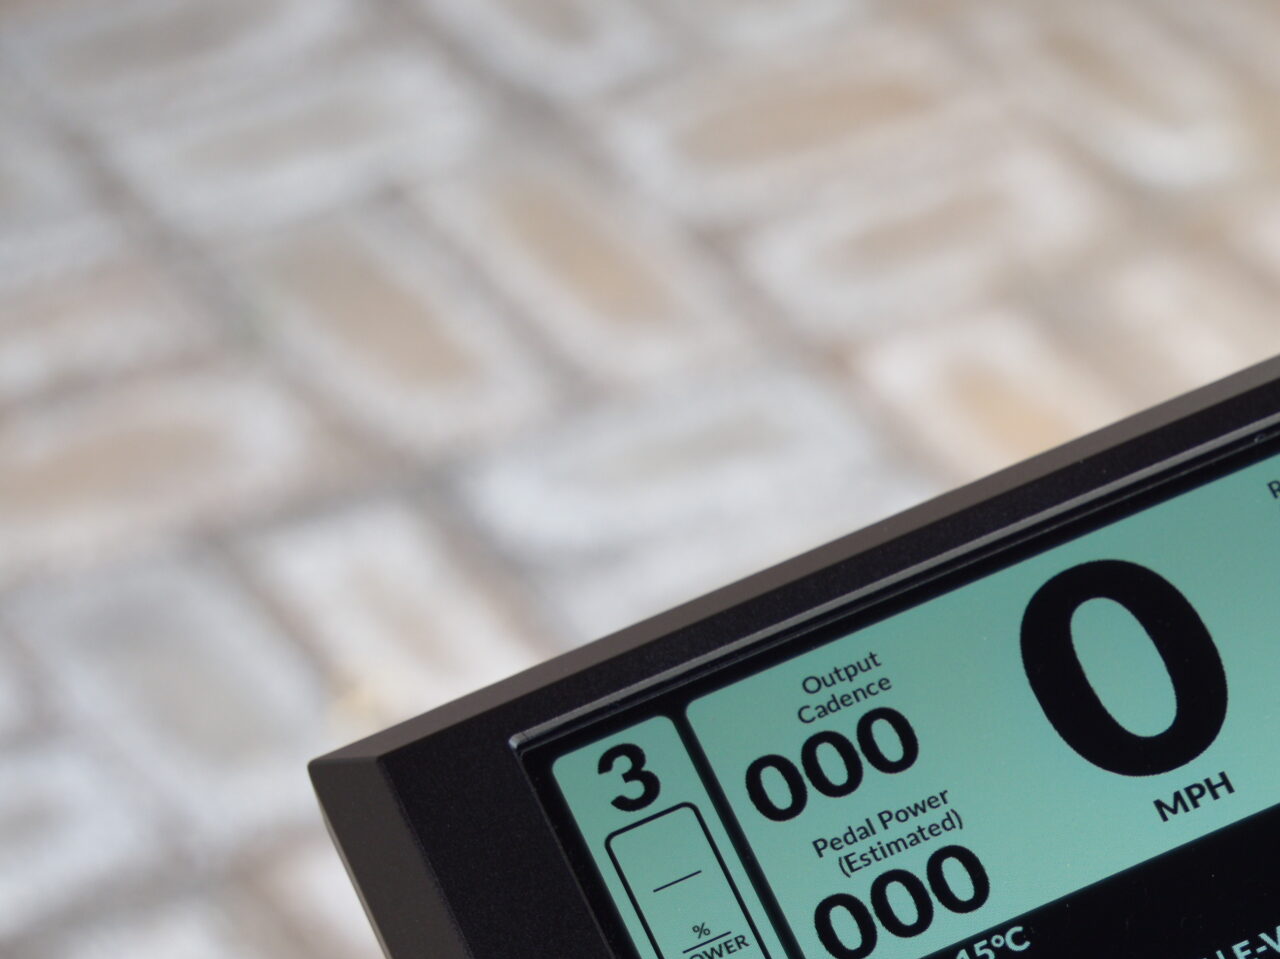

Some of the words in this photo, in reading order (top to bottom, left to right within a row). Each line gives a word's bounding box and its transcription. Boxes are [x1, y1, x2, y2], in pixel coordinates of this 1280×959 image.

[797, 675, 892, 725] Cadence
[801, 650, 882, 696] Output
[1019, 558, 1229, 778] 0
[597, 743, 661, 812] 3
[744, 706, 919, 822] 000
[1152, 770, 1235, 822] MPH
[812, 817, 876, 858] Pedal
[876, 787, 951, 835] Power
[837, 808, 965, 878] (Estimated)
[692, 921, 711, 939] %
